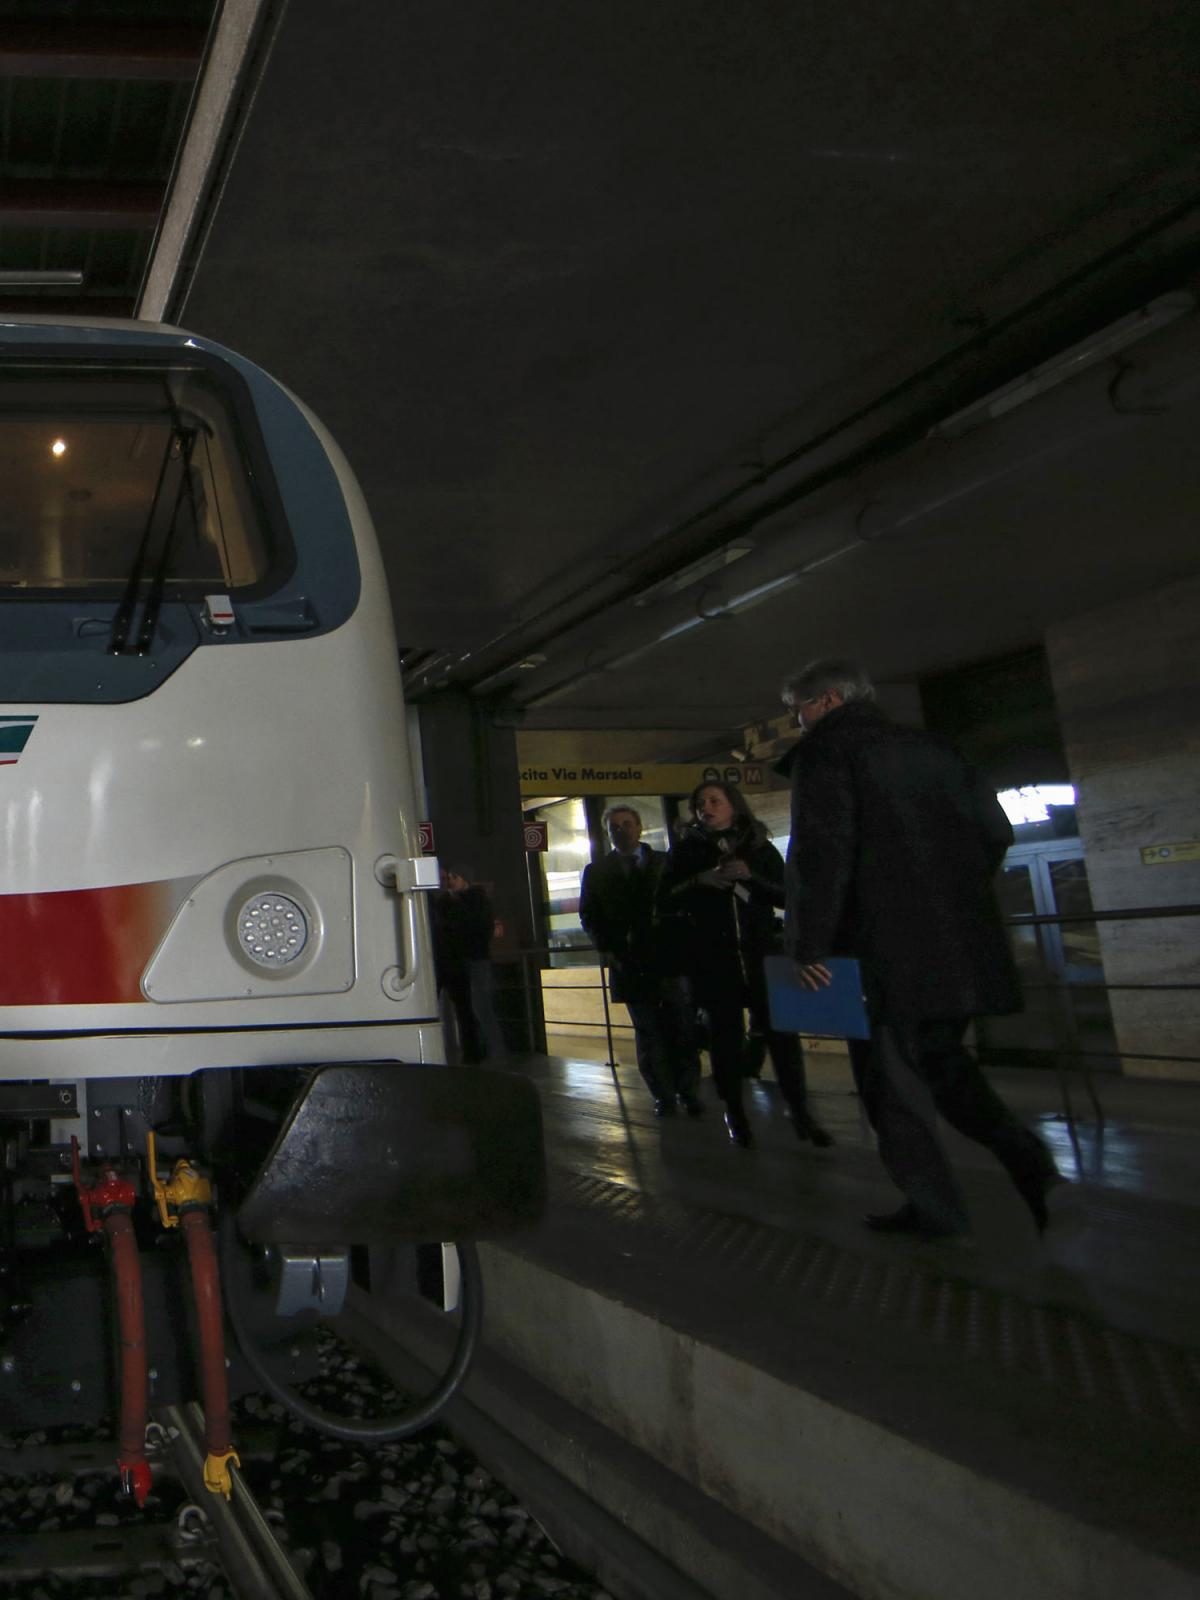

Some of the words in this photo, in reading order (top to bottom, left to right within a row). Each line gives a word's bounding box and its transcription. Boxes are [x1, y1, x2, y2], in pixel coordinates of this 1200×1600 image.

[519, 767, 548, 780] cita
[552, 767, 577, 780] Via
[581, 767, 642, 780] Marsala
[745, 768, 761, 783] M
